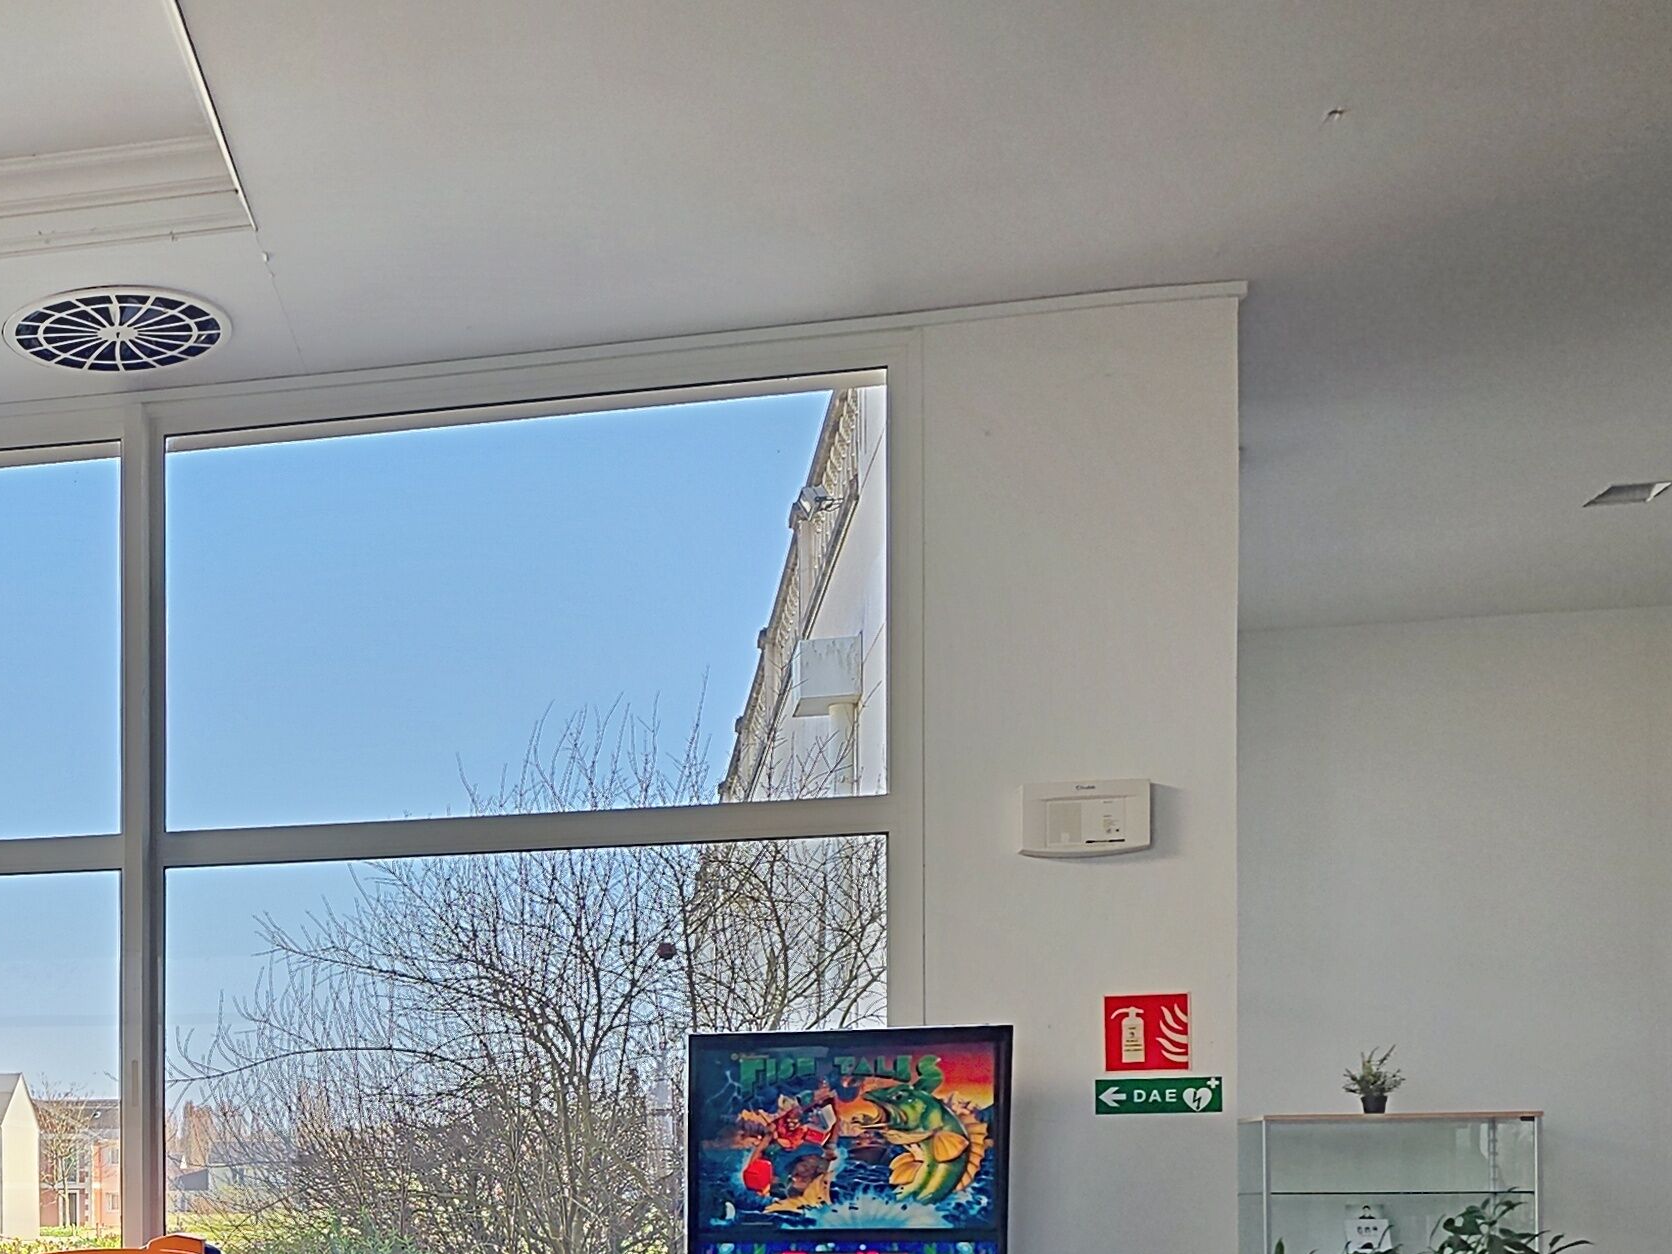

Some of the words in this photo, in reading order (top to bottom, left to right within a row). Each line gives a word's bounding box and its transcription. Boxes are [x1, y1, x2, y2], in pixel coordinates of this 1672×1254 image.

[740, 1056, 816, 1096] FISH
[833, 1054, 943, 1096] TALES
[1133, 1089, 1177, 1102] DAE
